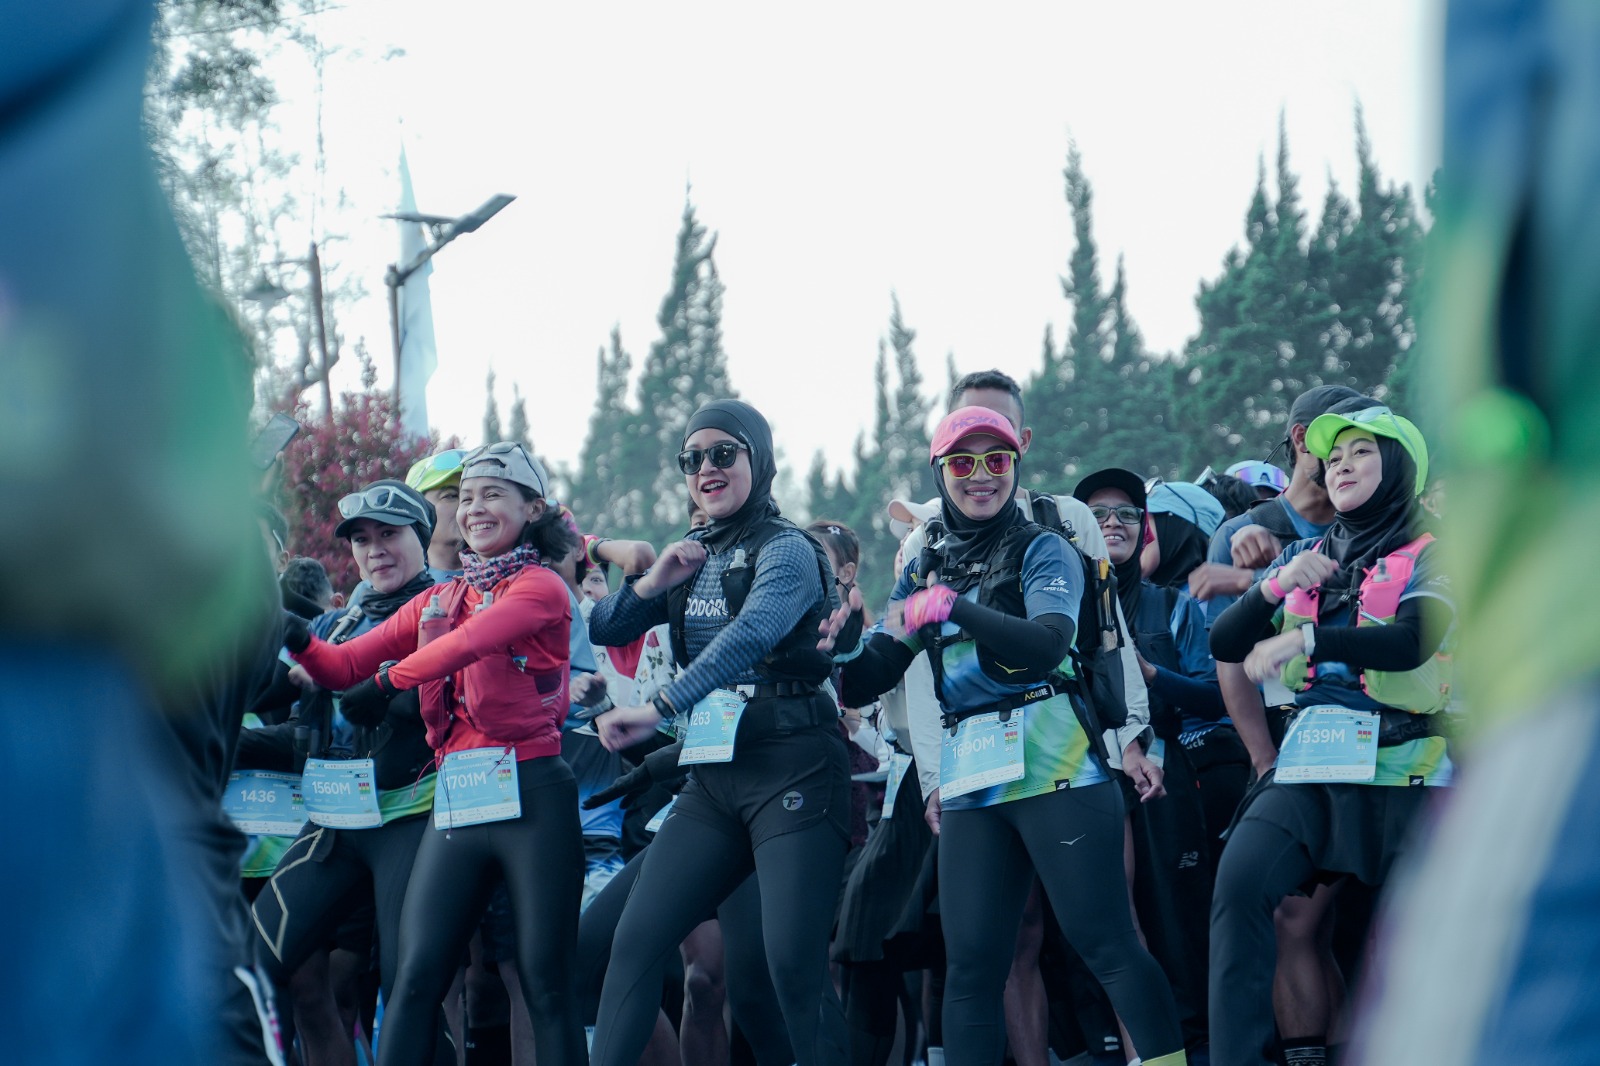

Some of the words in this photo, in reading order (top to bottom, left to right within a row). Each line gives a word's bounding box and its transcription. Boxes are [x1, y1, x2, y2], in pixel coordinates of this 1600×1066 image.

[952, 416, 999, 433] HOKA
[1297, 728, 1345, 744] 1539M
[952, 734, 996, 759] 1690M
[312, 780, 351, 795] 1560M
[446, 771, 487, 790] 1701M
[240, 790, 277, 803] 1436
